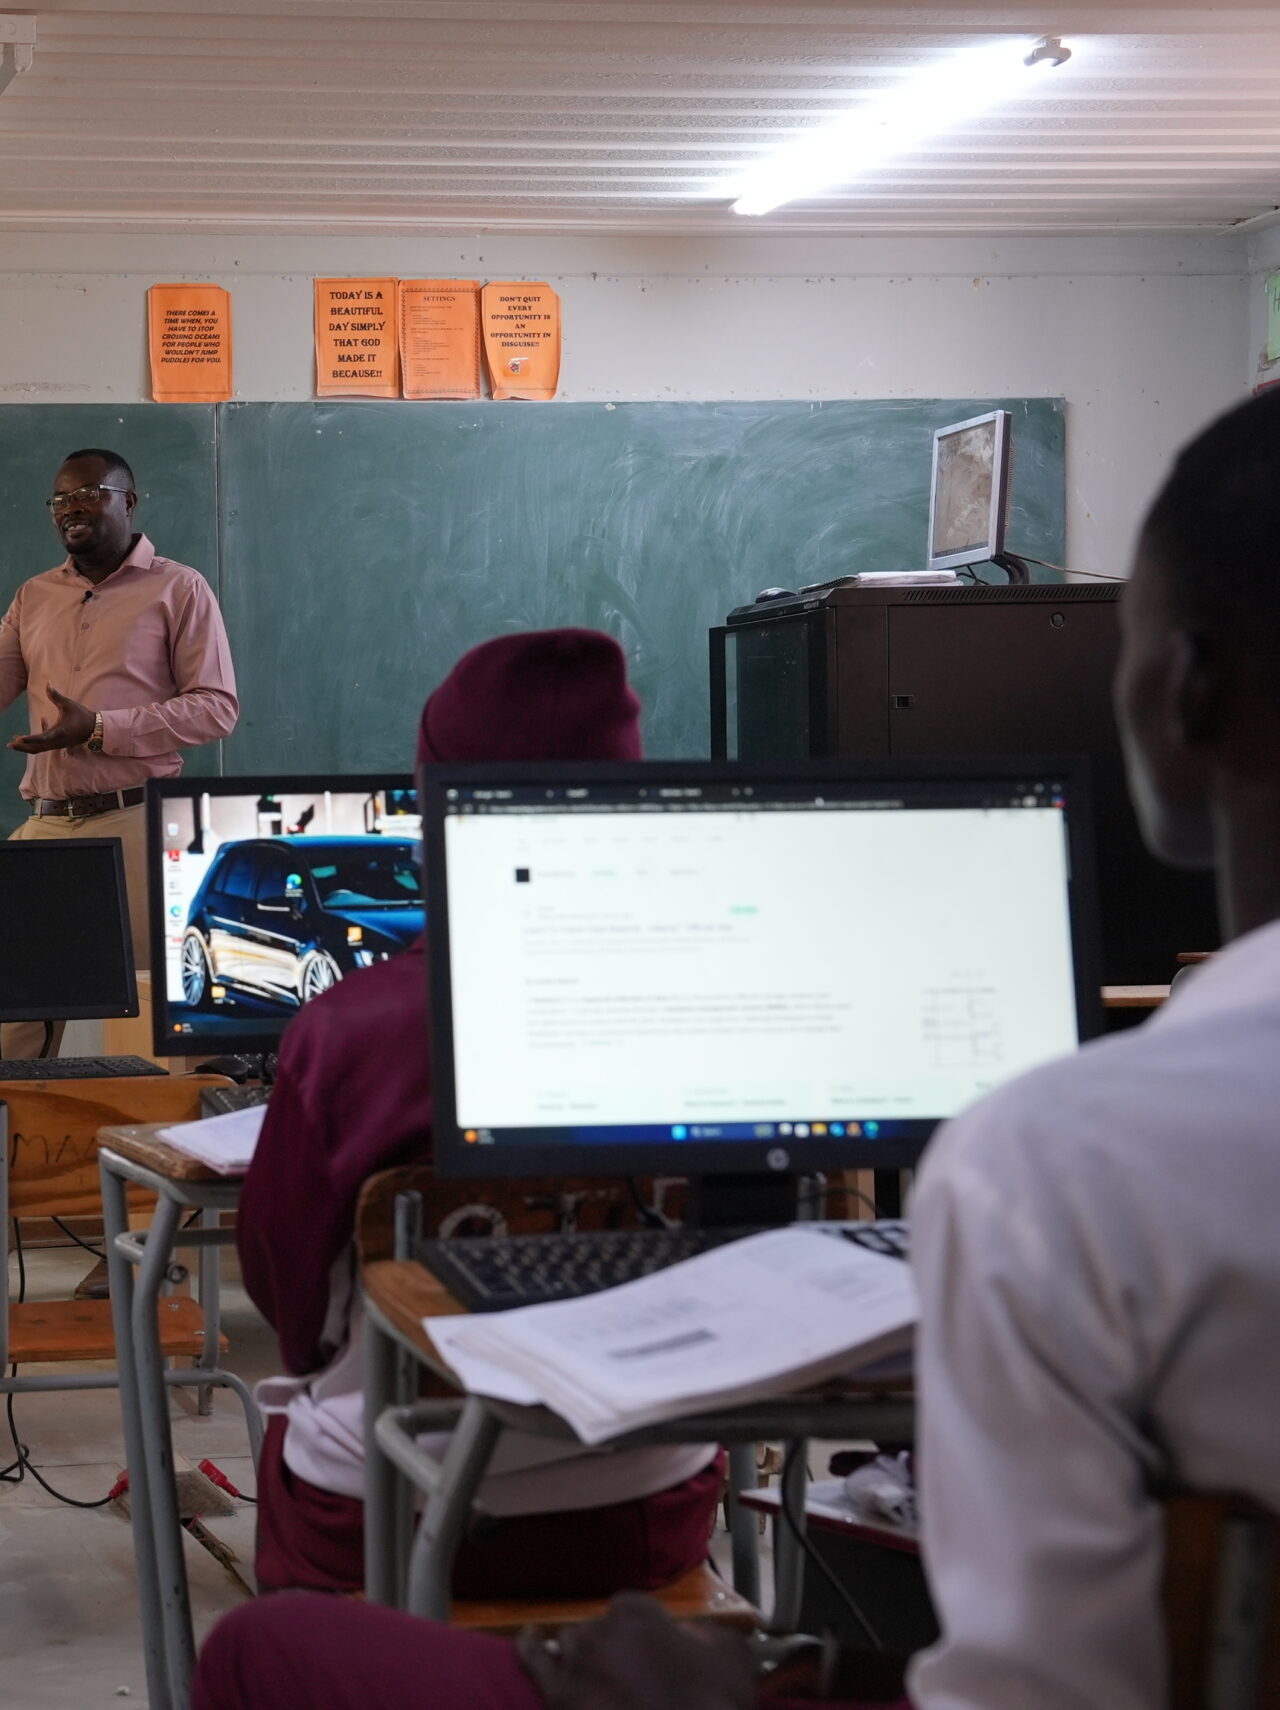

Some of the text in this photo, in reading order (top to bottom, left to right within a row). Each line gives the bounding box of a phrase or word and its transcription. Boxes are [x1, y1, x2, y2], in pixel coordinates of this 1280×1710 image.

[329, 290, 383, 300] TODAY IS A
[330, 307, 383, 315] BEAUTIFUL
[329, 321, 386, 331] DAY SIMPLY
[333, 339, 381, 347] THAT GOD
[337, 354, 377, 363] MADE IT
[332, 370, 383, 378] BECAUSE!!
